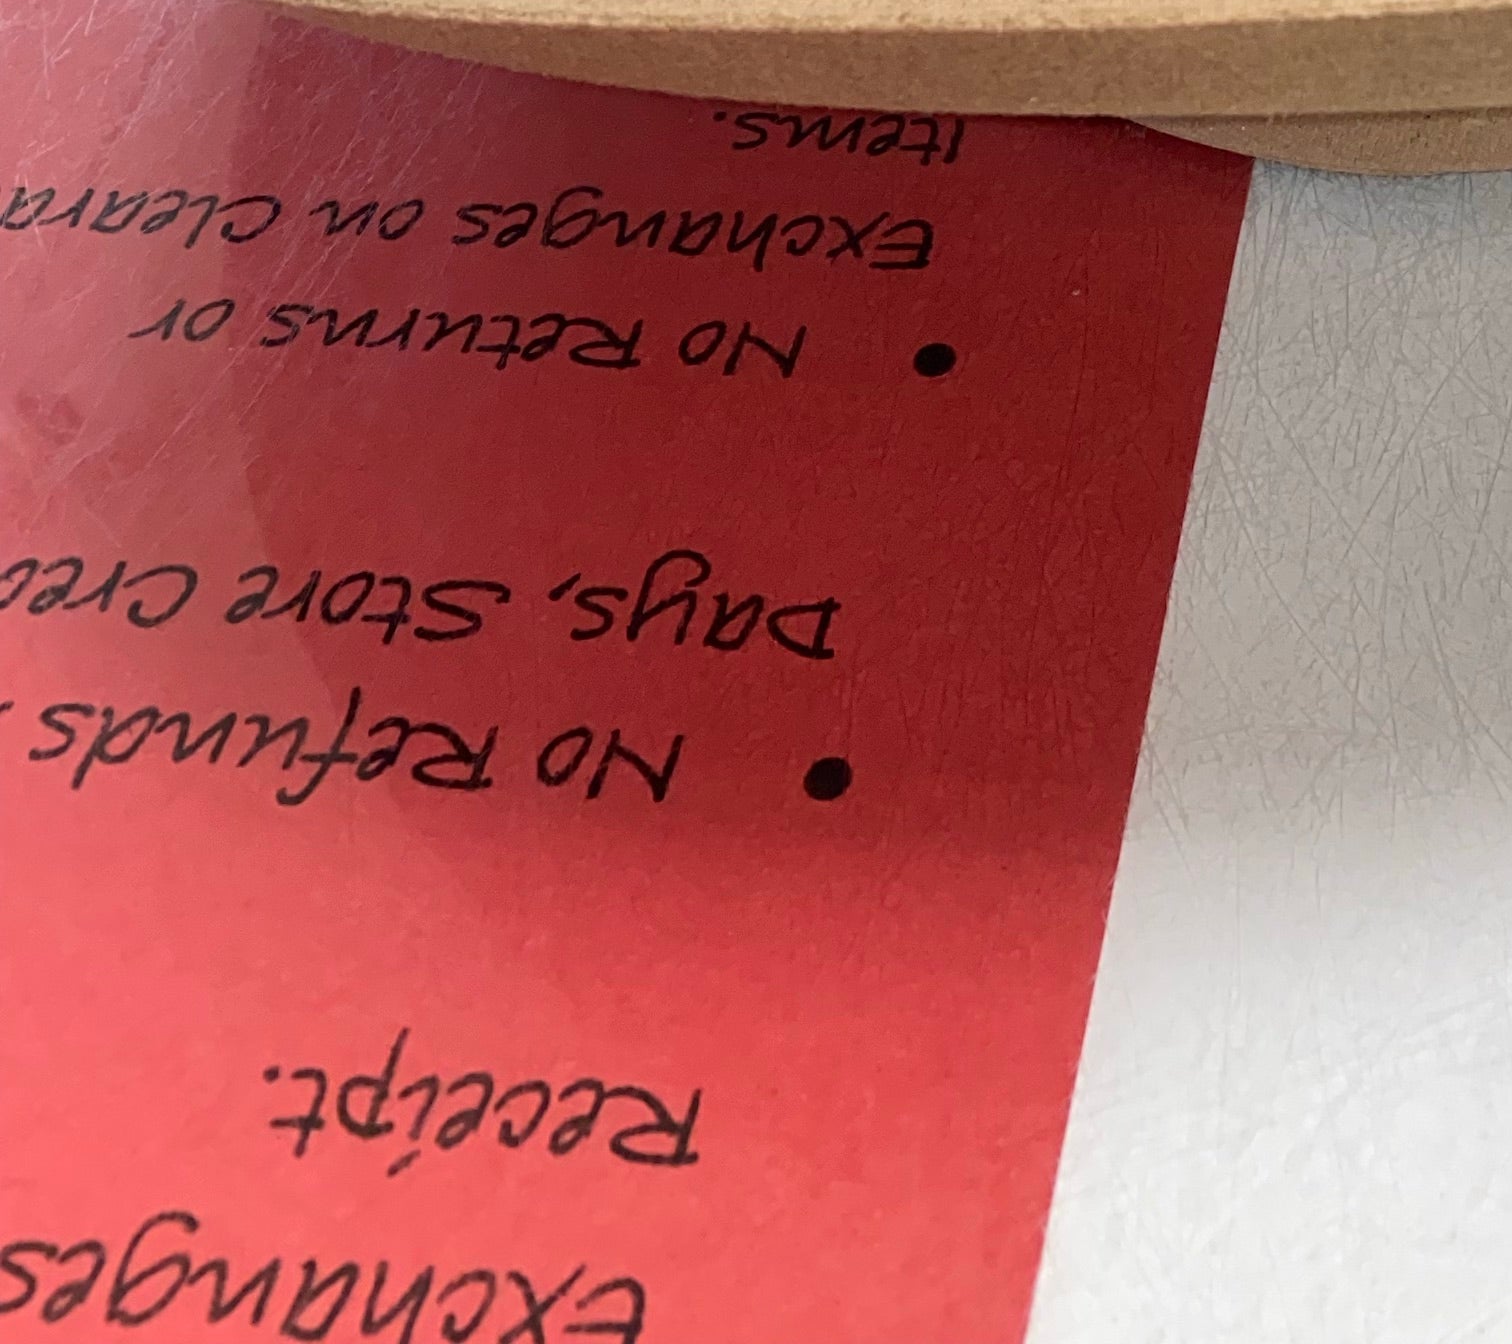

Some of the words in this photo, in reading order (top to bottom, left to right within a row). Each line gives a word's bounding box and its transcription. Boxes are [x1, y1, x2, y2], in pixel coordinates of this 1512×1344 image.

[712, 110, 965, 164] Items.
[309, 200, 424, 244] on
[453, 184, 934, 272] Exchanges
[128, 297, 235, 345] or
[262, 304, 645, 372] Returns
[677, 320, 808, 379] No
[222, 565, 511, 646] Store
[546, 549, 842, 662] Days,
[27, 688, 500, 806] Refunds
[536, 726, 684, 804] No
[262, 1026, 702, 1178] Receipt.
[0, 1210, 648, 1344] Exchanges
